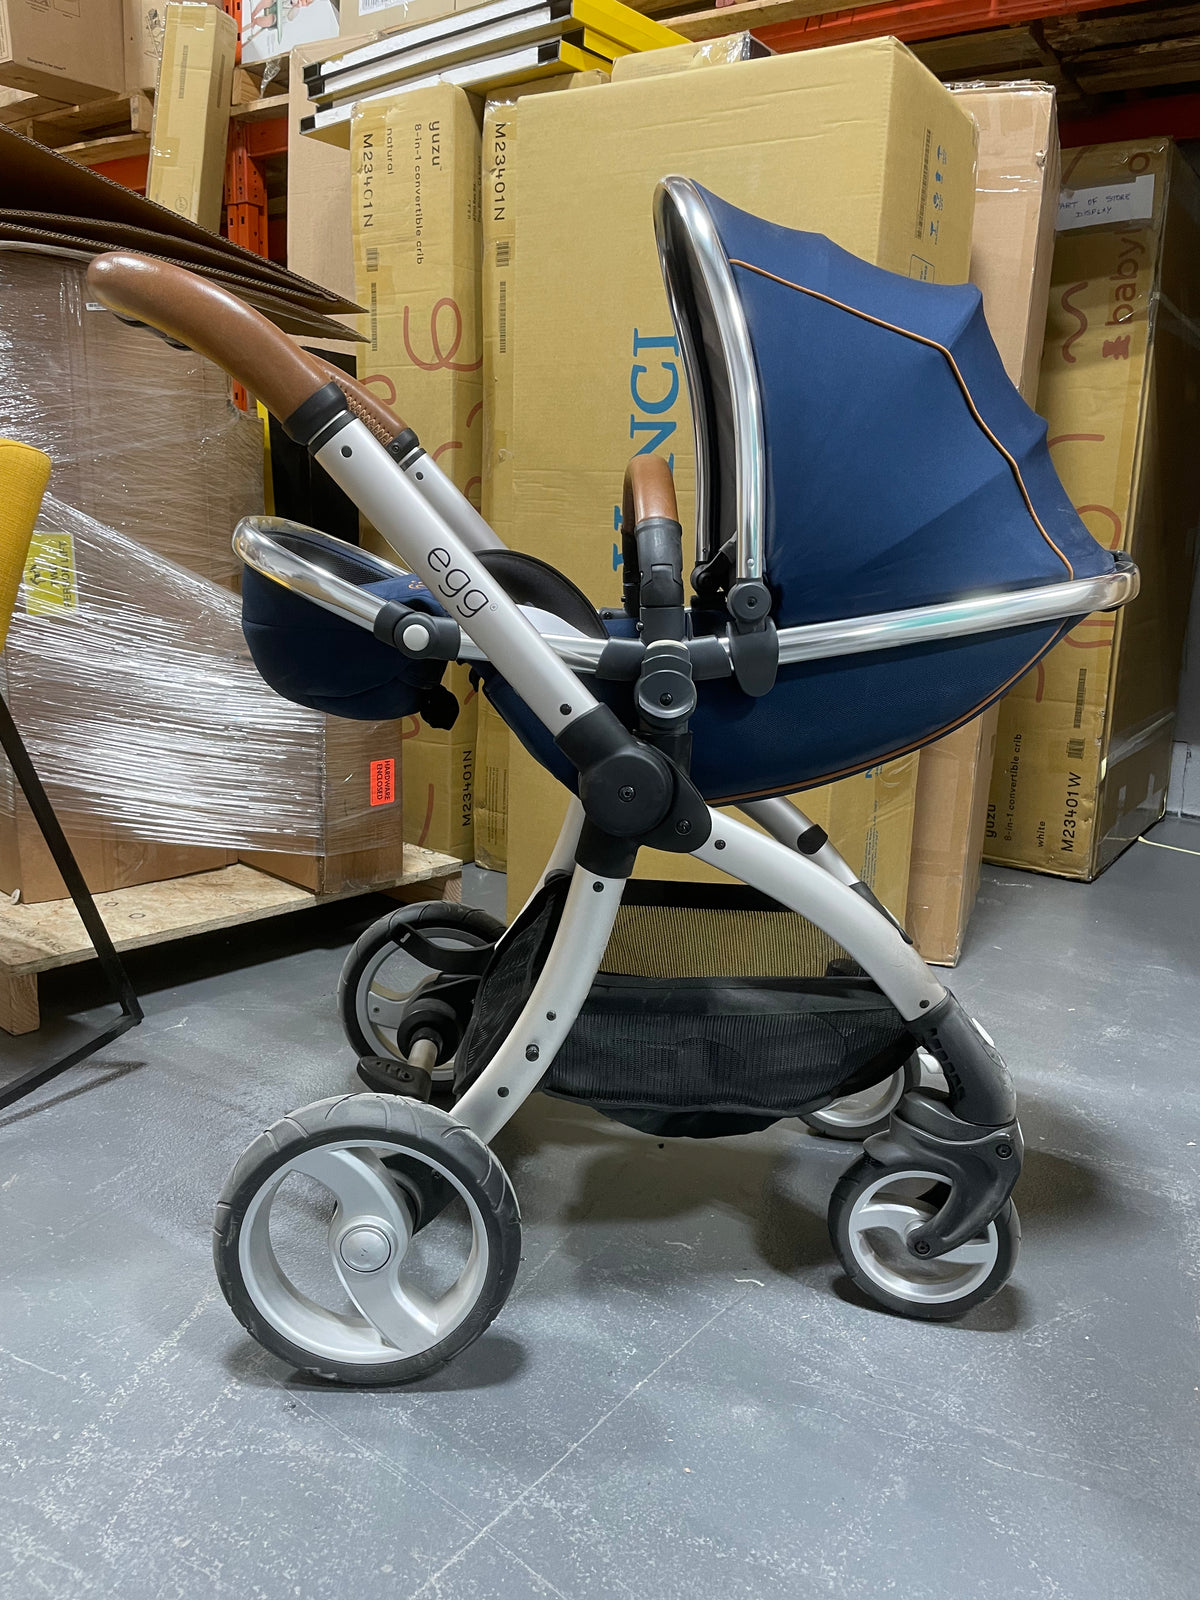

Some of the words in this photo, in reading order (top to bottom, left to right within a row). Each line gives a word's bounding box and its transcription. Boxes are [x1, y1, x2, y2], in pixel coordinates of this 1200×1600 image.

[386, 127, 394, 175] natural
[414, 123, 422, 161] 8-in-1
[363, 133, 374, 228] M23401N
[494, 123, 506, 221] M23401N
[414, 165, 423, 237] convertible
[1058, 201, 1078, 210] ART
[1087, 196, 1099, 206] OF
[1105, 193, 1131, 203] STORE
[1075, 206, 1112, 218] DISPLAY
[416, 240, 425, 265] crib
[1013, 733, 1022, 753] crib
[462, 750, 472, 826] M23401N
[1008, 755, 1020, 811] convertible
[985, 803, 998, 838] yuzu
[1003, 812, 1014, 841] 8-in-1
[1061, 771, 1081, 852] M23401W
[1036, 821, 1046, 848] white
